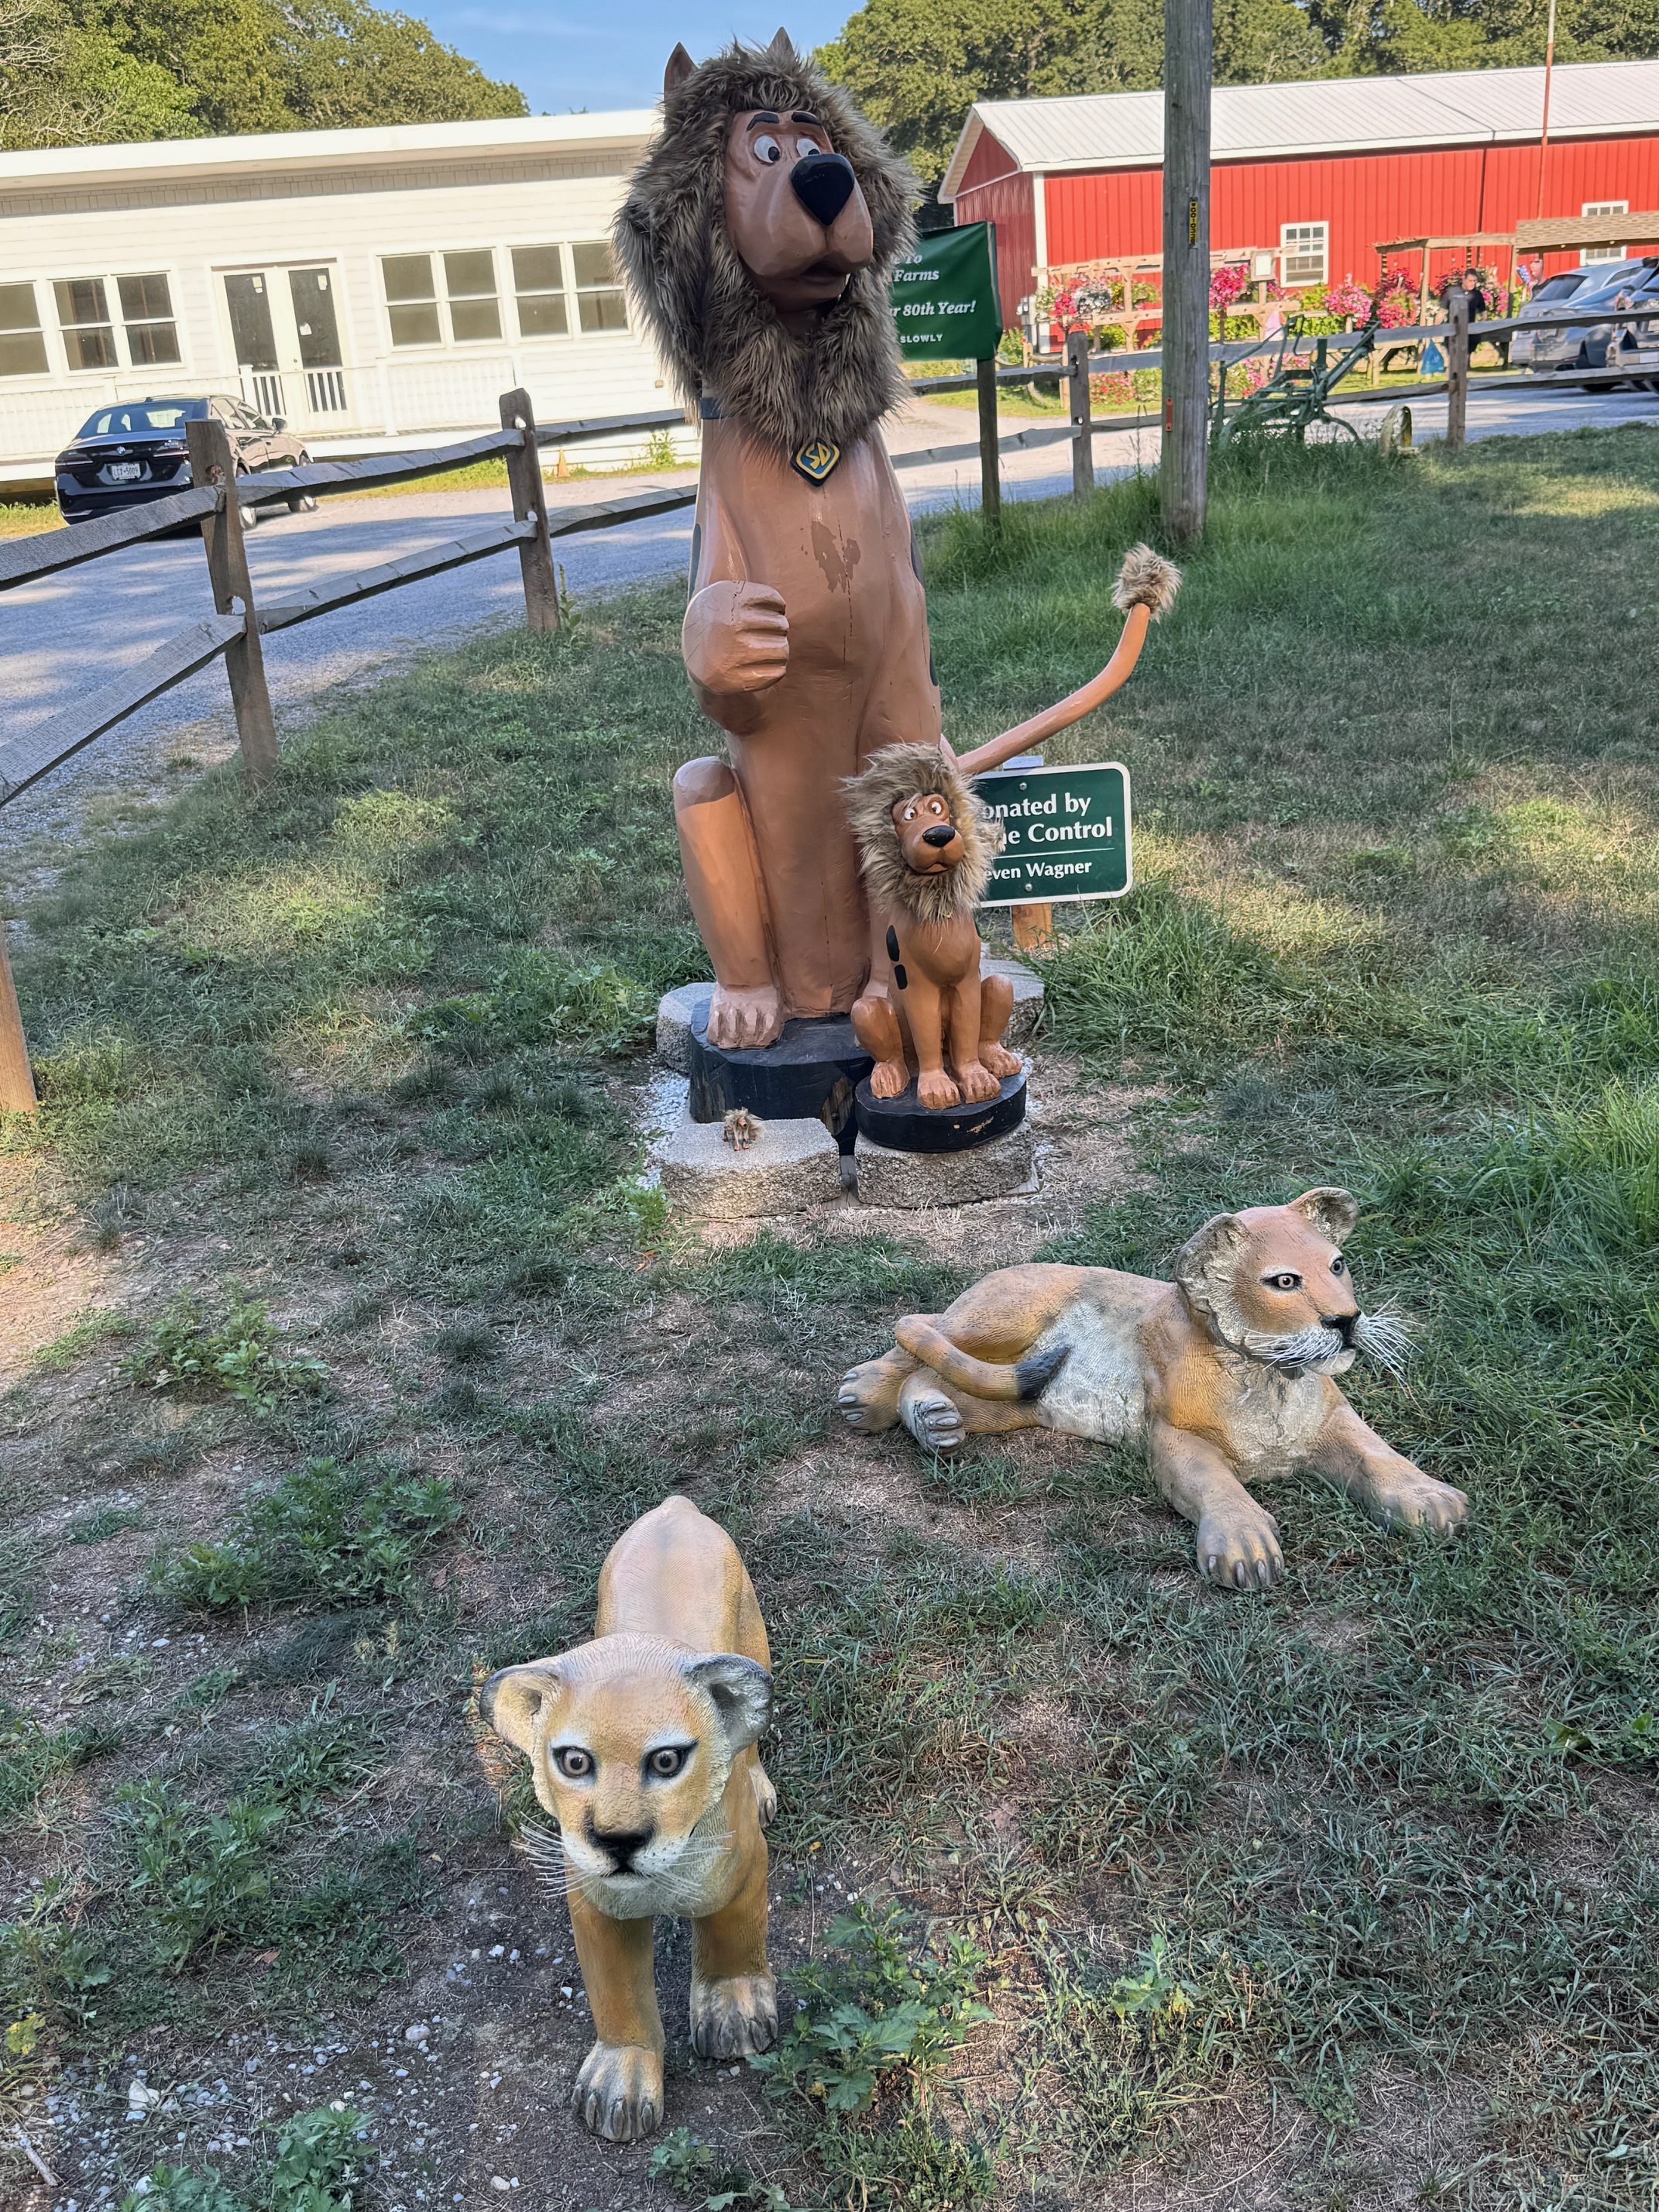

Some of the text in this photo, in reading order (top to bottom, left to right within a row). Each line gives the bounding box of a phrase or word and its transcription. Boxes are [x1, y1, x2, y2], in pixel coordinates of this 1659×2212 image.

[894, 270, 939, 282] Farms
[902, 301, 935, 317] 80th
[938, 301, 977, 314] Year!
[900, 335, 943, 343] SLOWLY
[983, 792, 1091, 819] onated by
[1028, 816, 1112, 843] Control
[984, 861, 1092, 881] even Wagner
